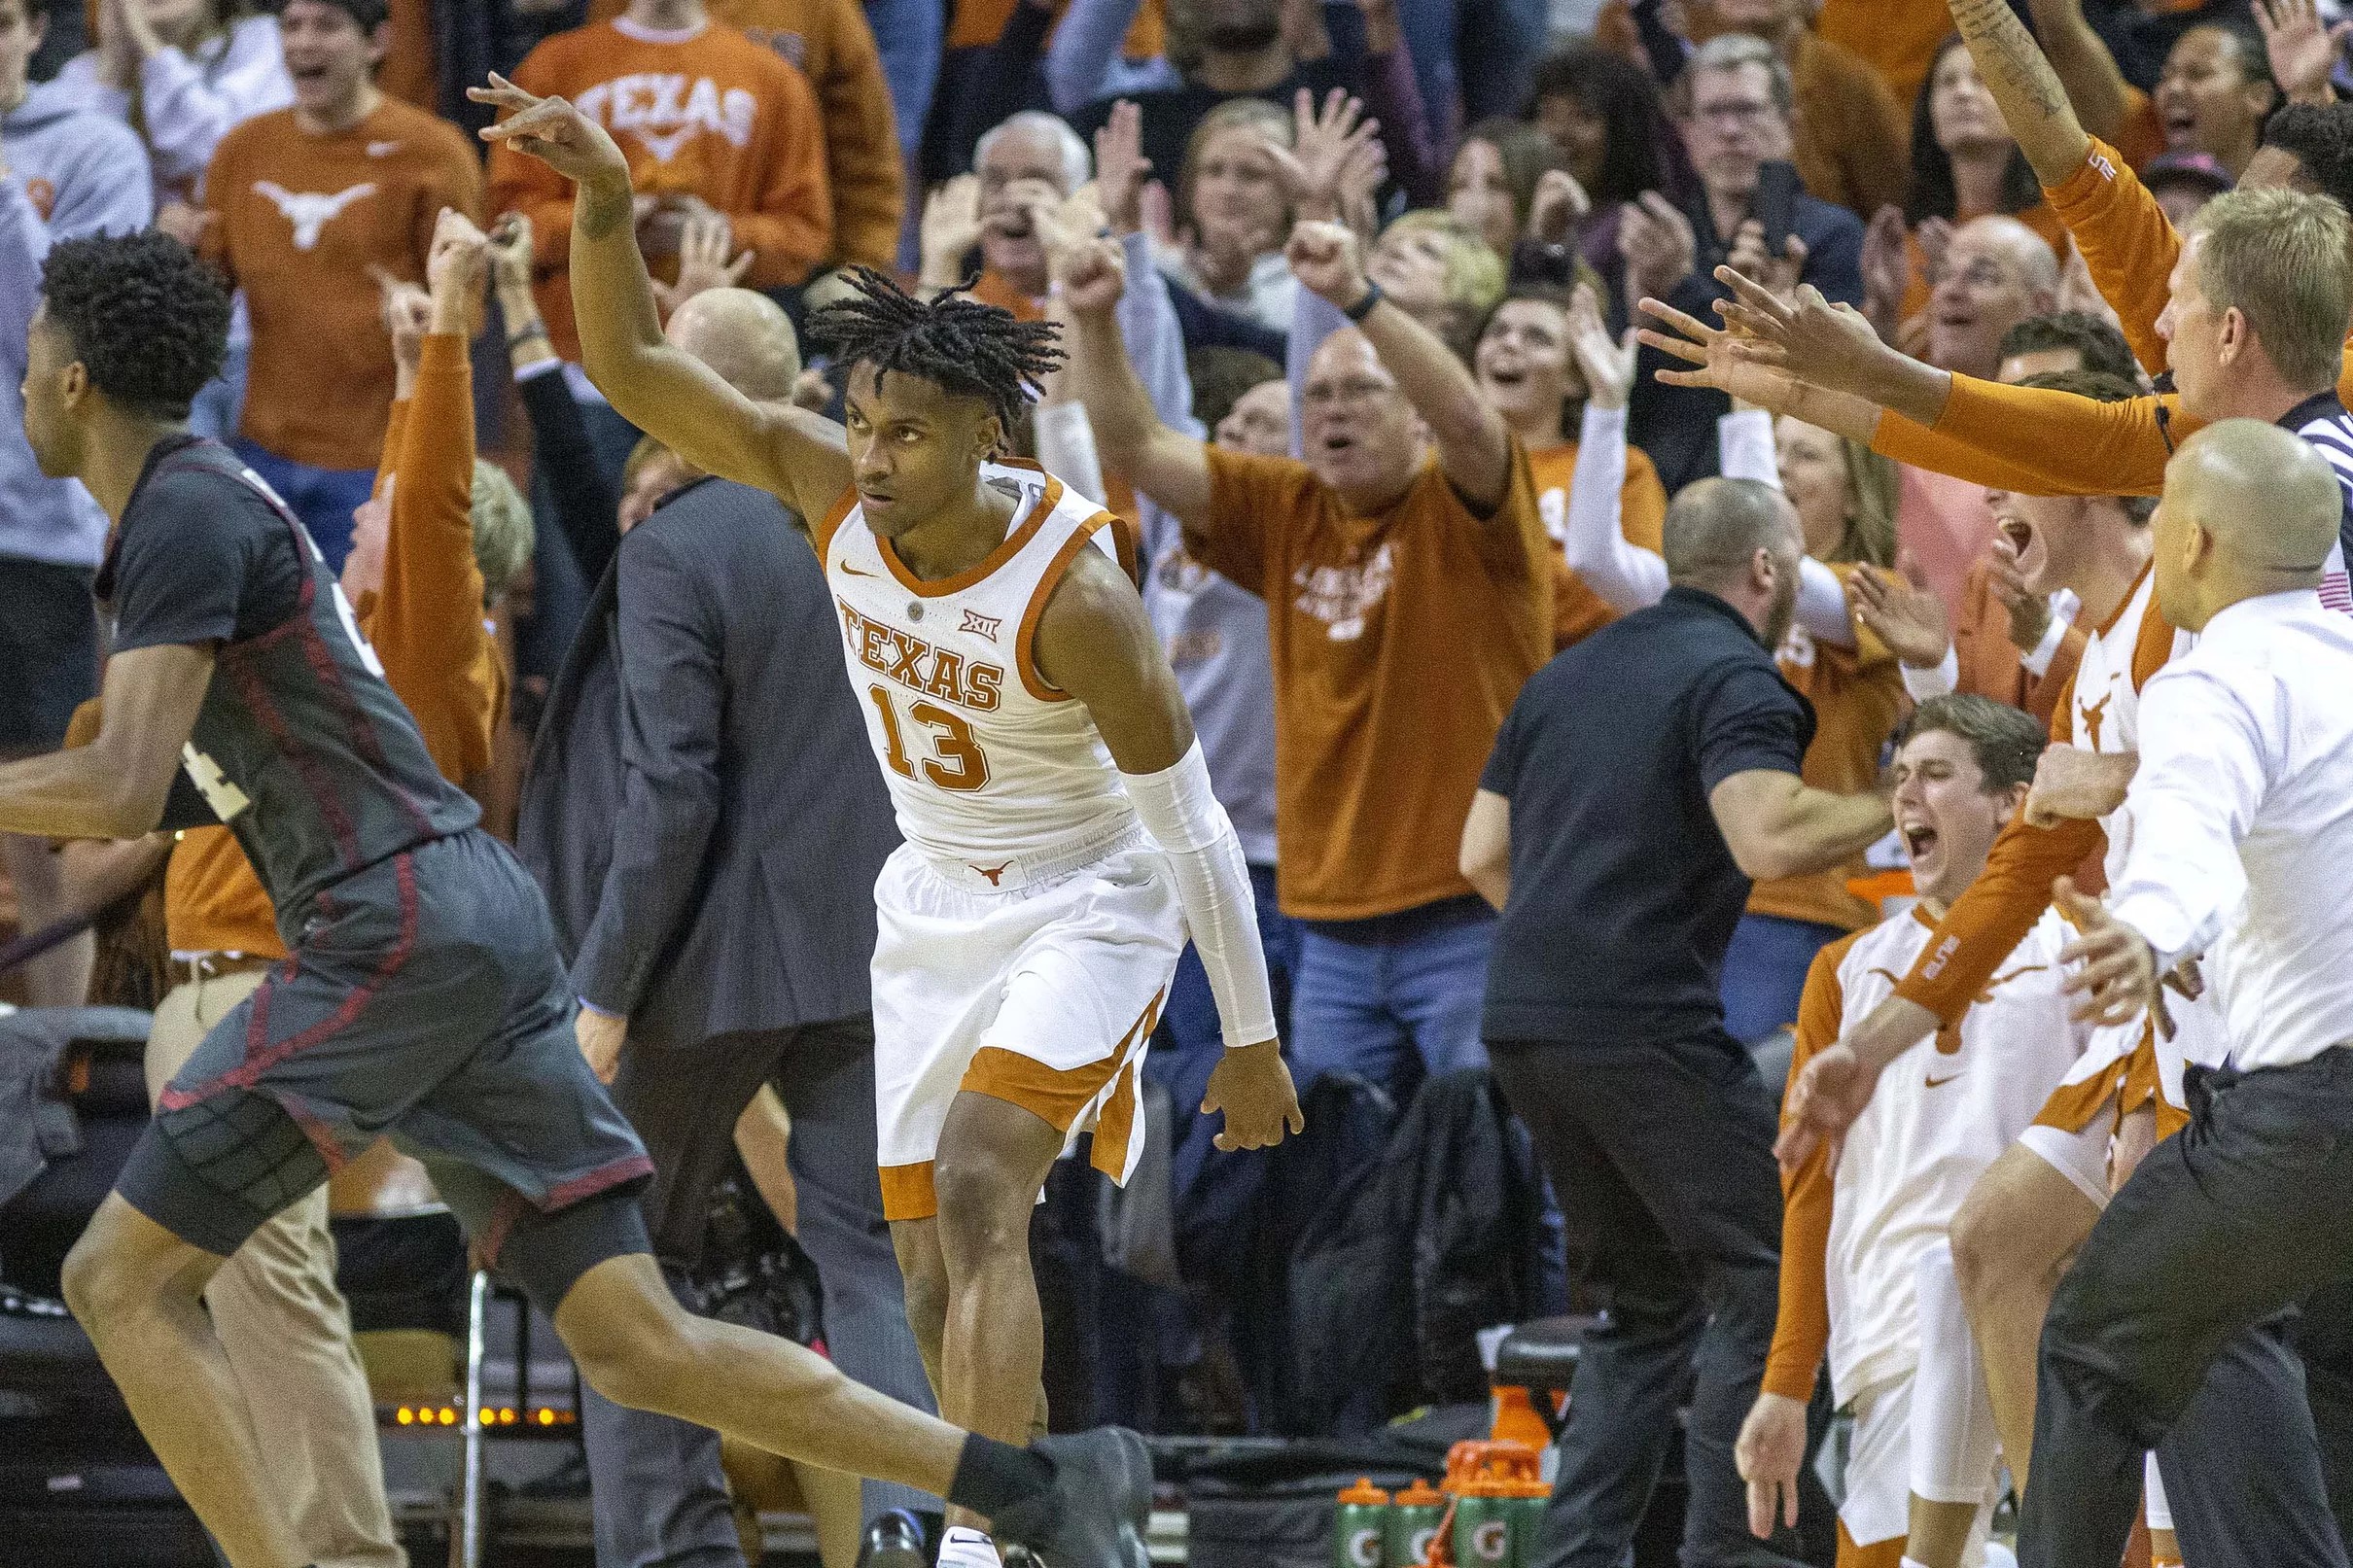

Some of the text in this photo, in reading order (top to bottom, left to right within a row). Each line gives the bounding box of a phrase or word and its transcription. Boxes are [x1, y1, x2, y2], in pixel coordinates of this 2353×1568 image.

[837, 595, 1004, 713] TEXAS
[868, 683, 991, 792] 13
[1474, 1519, 1506, 1560] G
